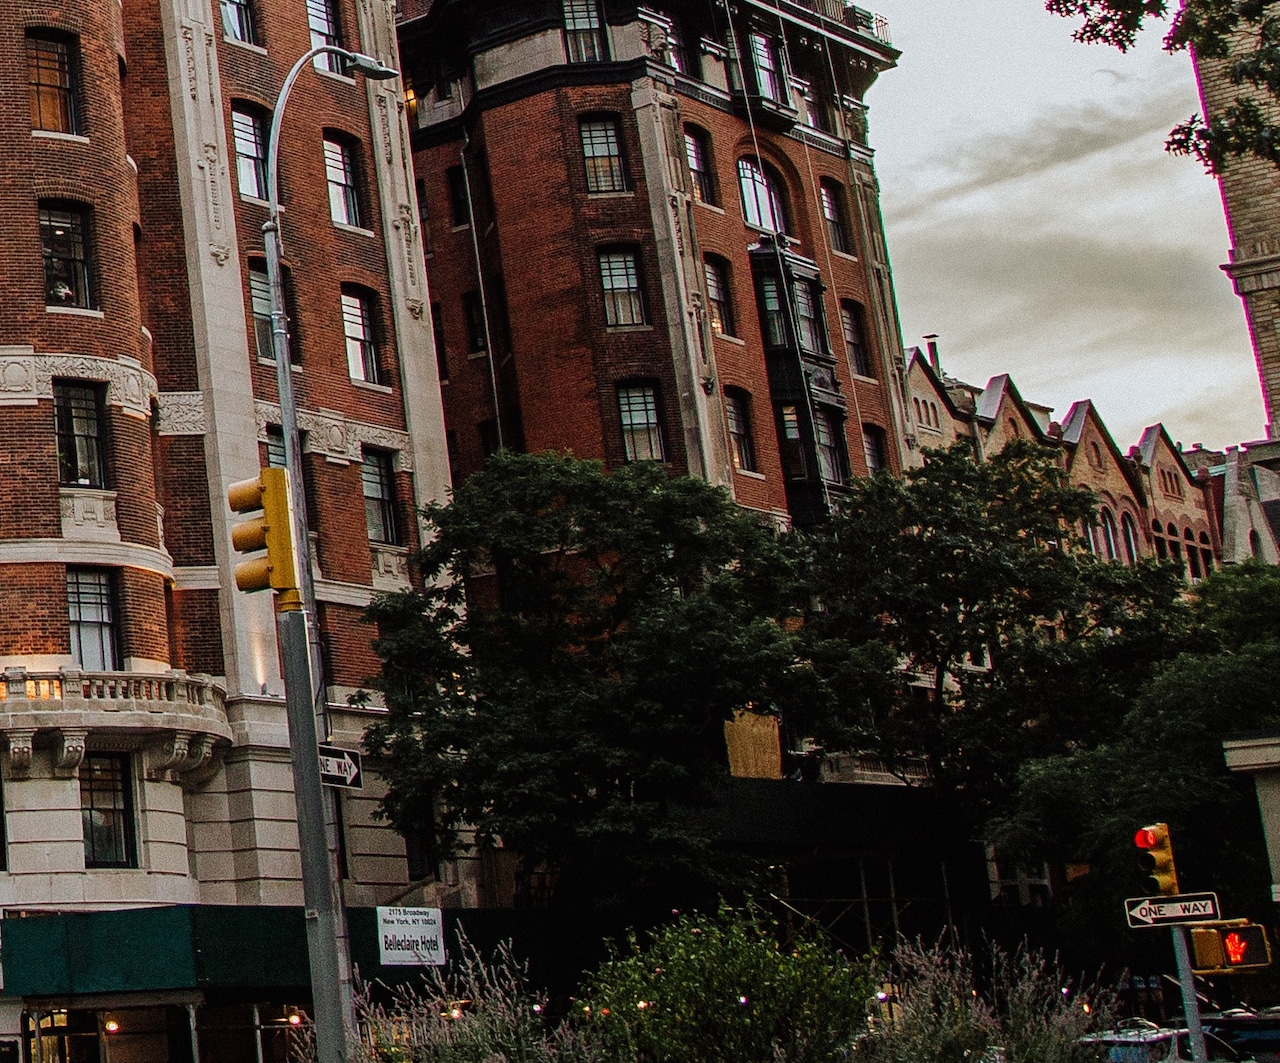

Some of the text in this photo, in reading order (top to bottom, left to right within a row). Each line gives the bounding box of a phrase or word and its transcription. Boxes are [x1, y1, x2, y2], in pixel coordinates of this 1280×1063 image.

[320, 758, 352, 776] NE WAY
[402, 908, 429, 917] Broadway
[1139, 902, 1208, 918] ONE WAY
[384, 934, 439, 951] Belleclaire Hotel
